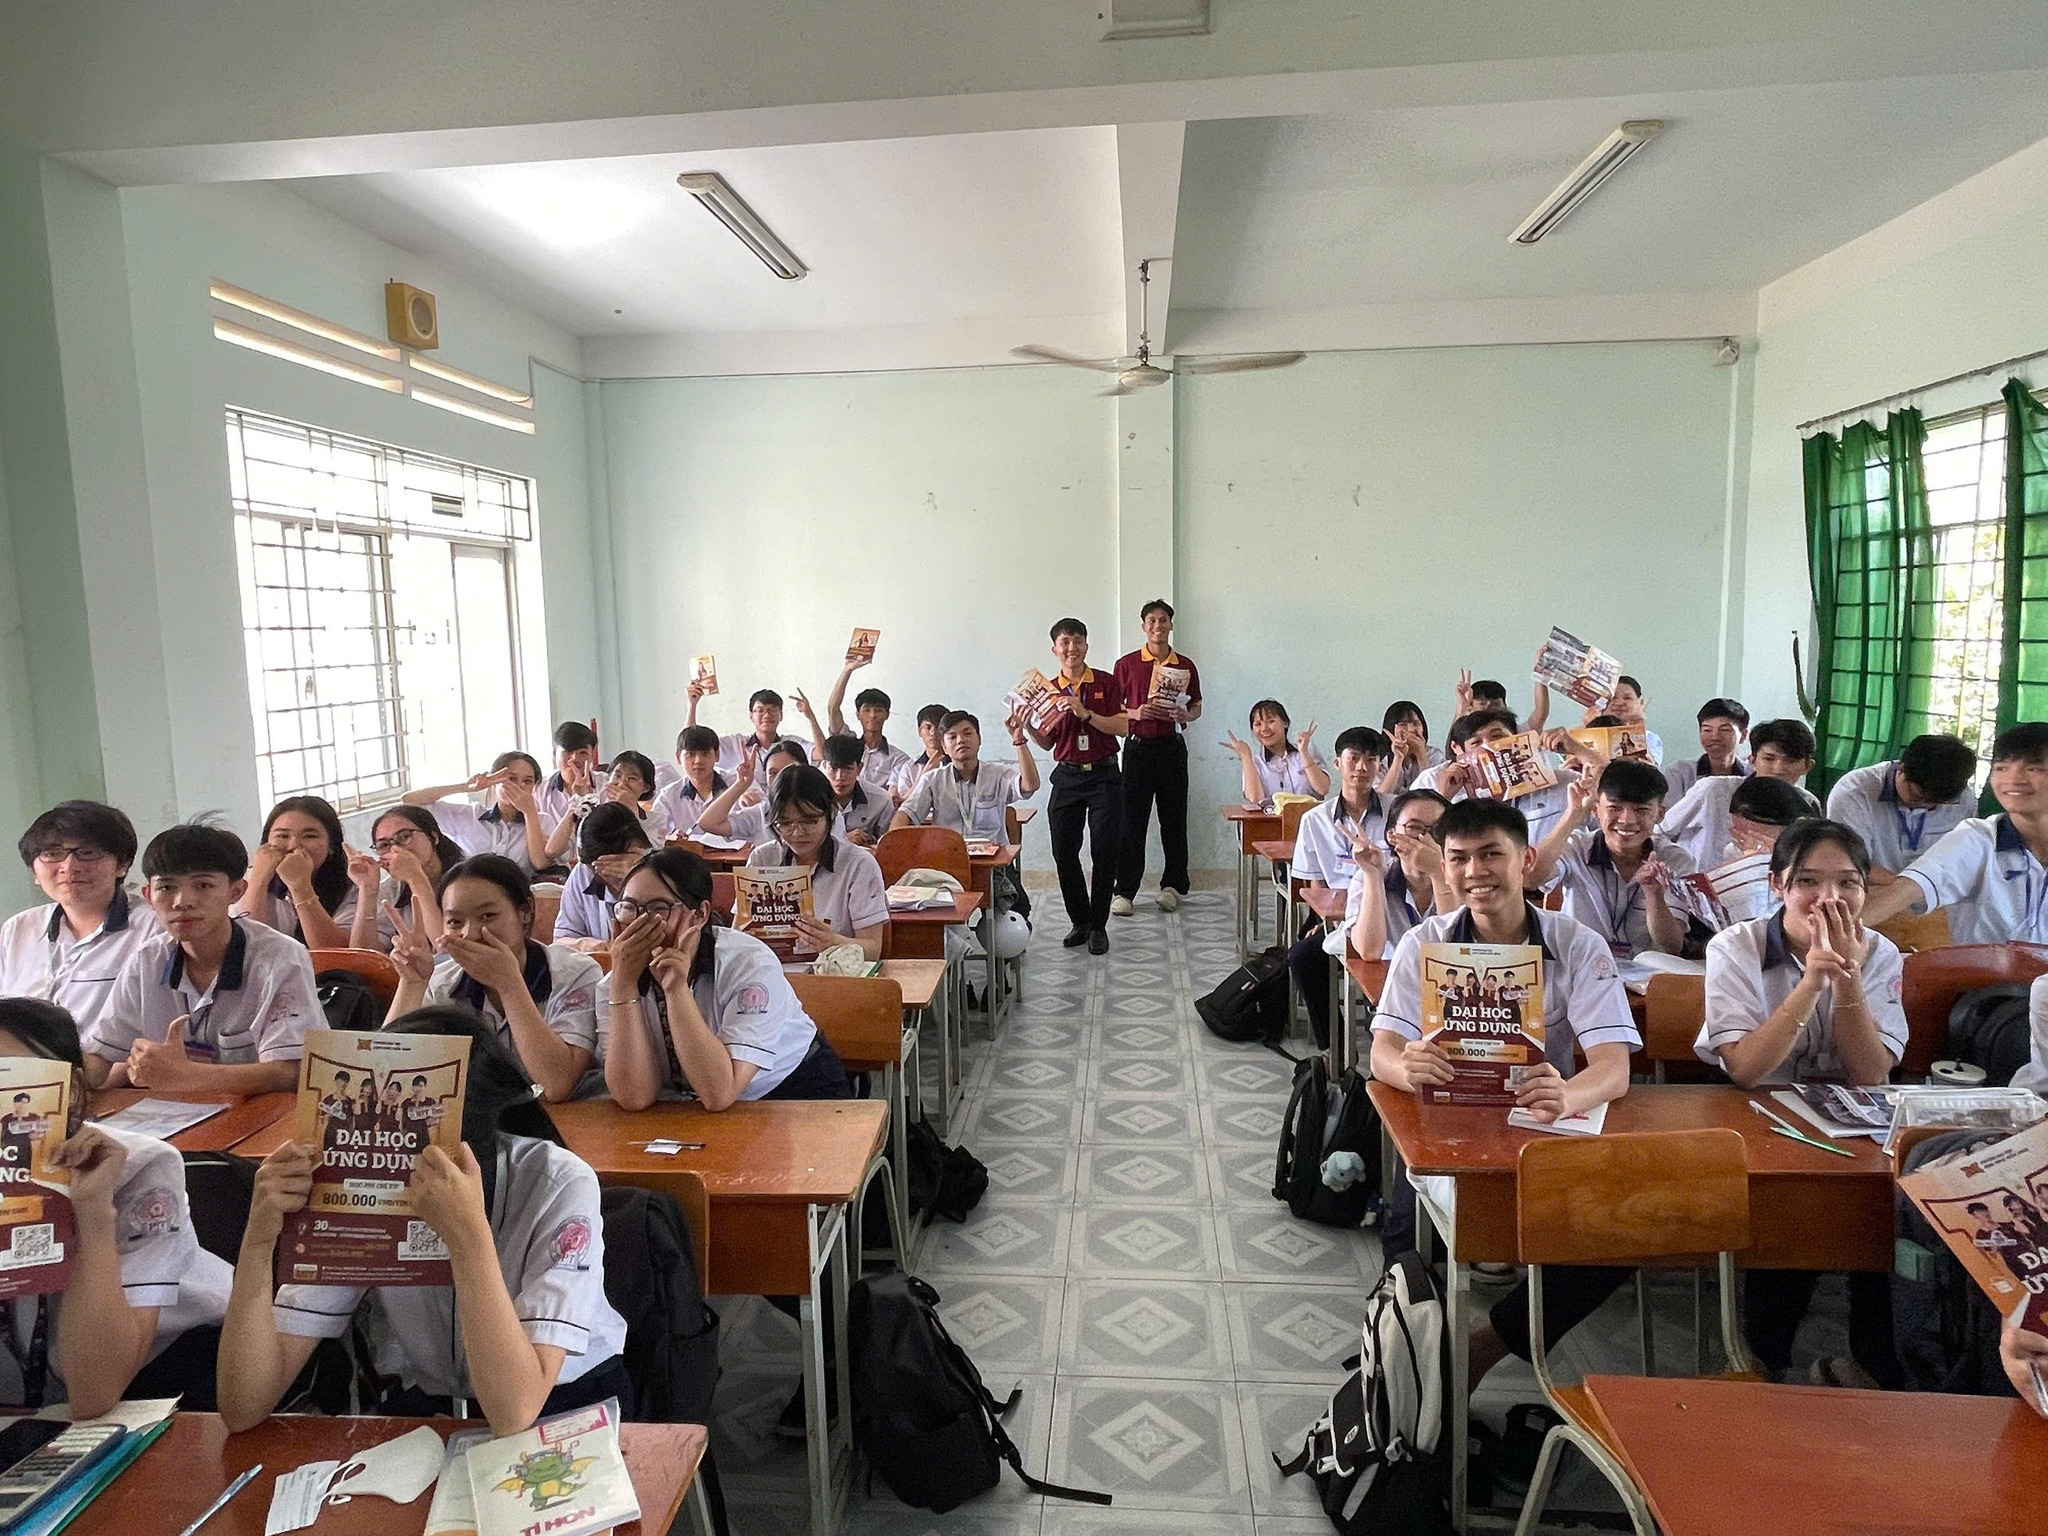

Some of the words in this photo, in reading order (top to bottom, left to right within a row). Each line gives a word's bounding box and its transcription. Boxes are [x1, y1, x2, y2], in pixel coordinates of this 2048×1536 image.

[1452, 1006, 1477, 1020] ĐẠI
[1480, 1007, 1512, 1022] HỌC
[1444, 1017, 1476, 1032] ỨNG
[1479, 1021, 1521, 1036] DỤNG
[336, 1129, 371, 1150] ĐẠI
[374, 1131, 417, 1151] HỌC
[323, 1147, 367, 1168] ỨNG
[371, 1152, 417, 1173] DỤN
[322, 1193, 377, 1206] 800.000
[313, 1220, 328, 1231] 30
